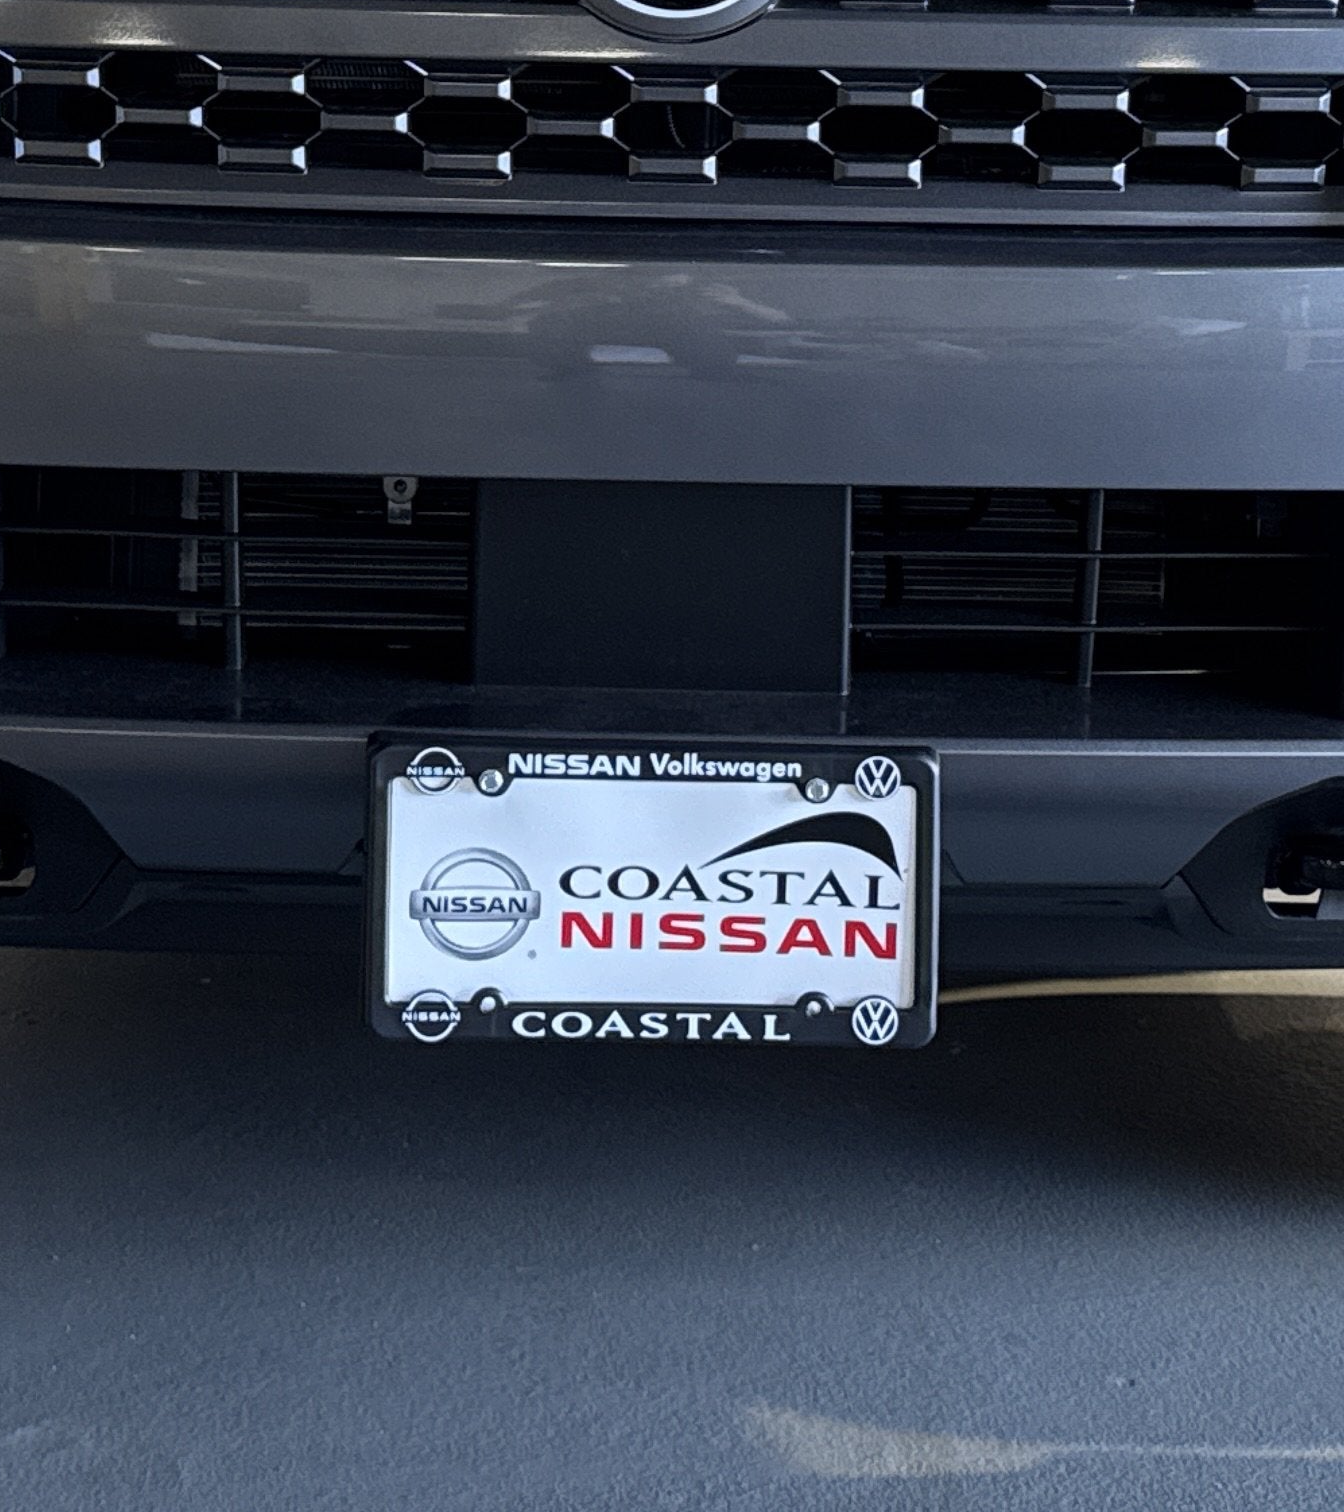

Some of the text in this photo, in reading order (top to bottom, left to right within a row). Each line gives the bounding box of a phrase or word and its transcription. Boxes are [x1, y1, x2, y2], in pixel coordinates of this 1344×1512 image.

[509, 753, 802, 780] NISSAN Volkswagen
[559, 864, 901, 910] COASTAL
[422, 896, 527, 914] NISSAN
[561, 912, 897, 960] NISSAN
[512, 1011, 791, 1042] COASTAL
